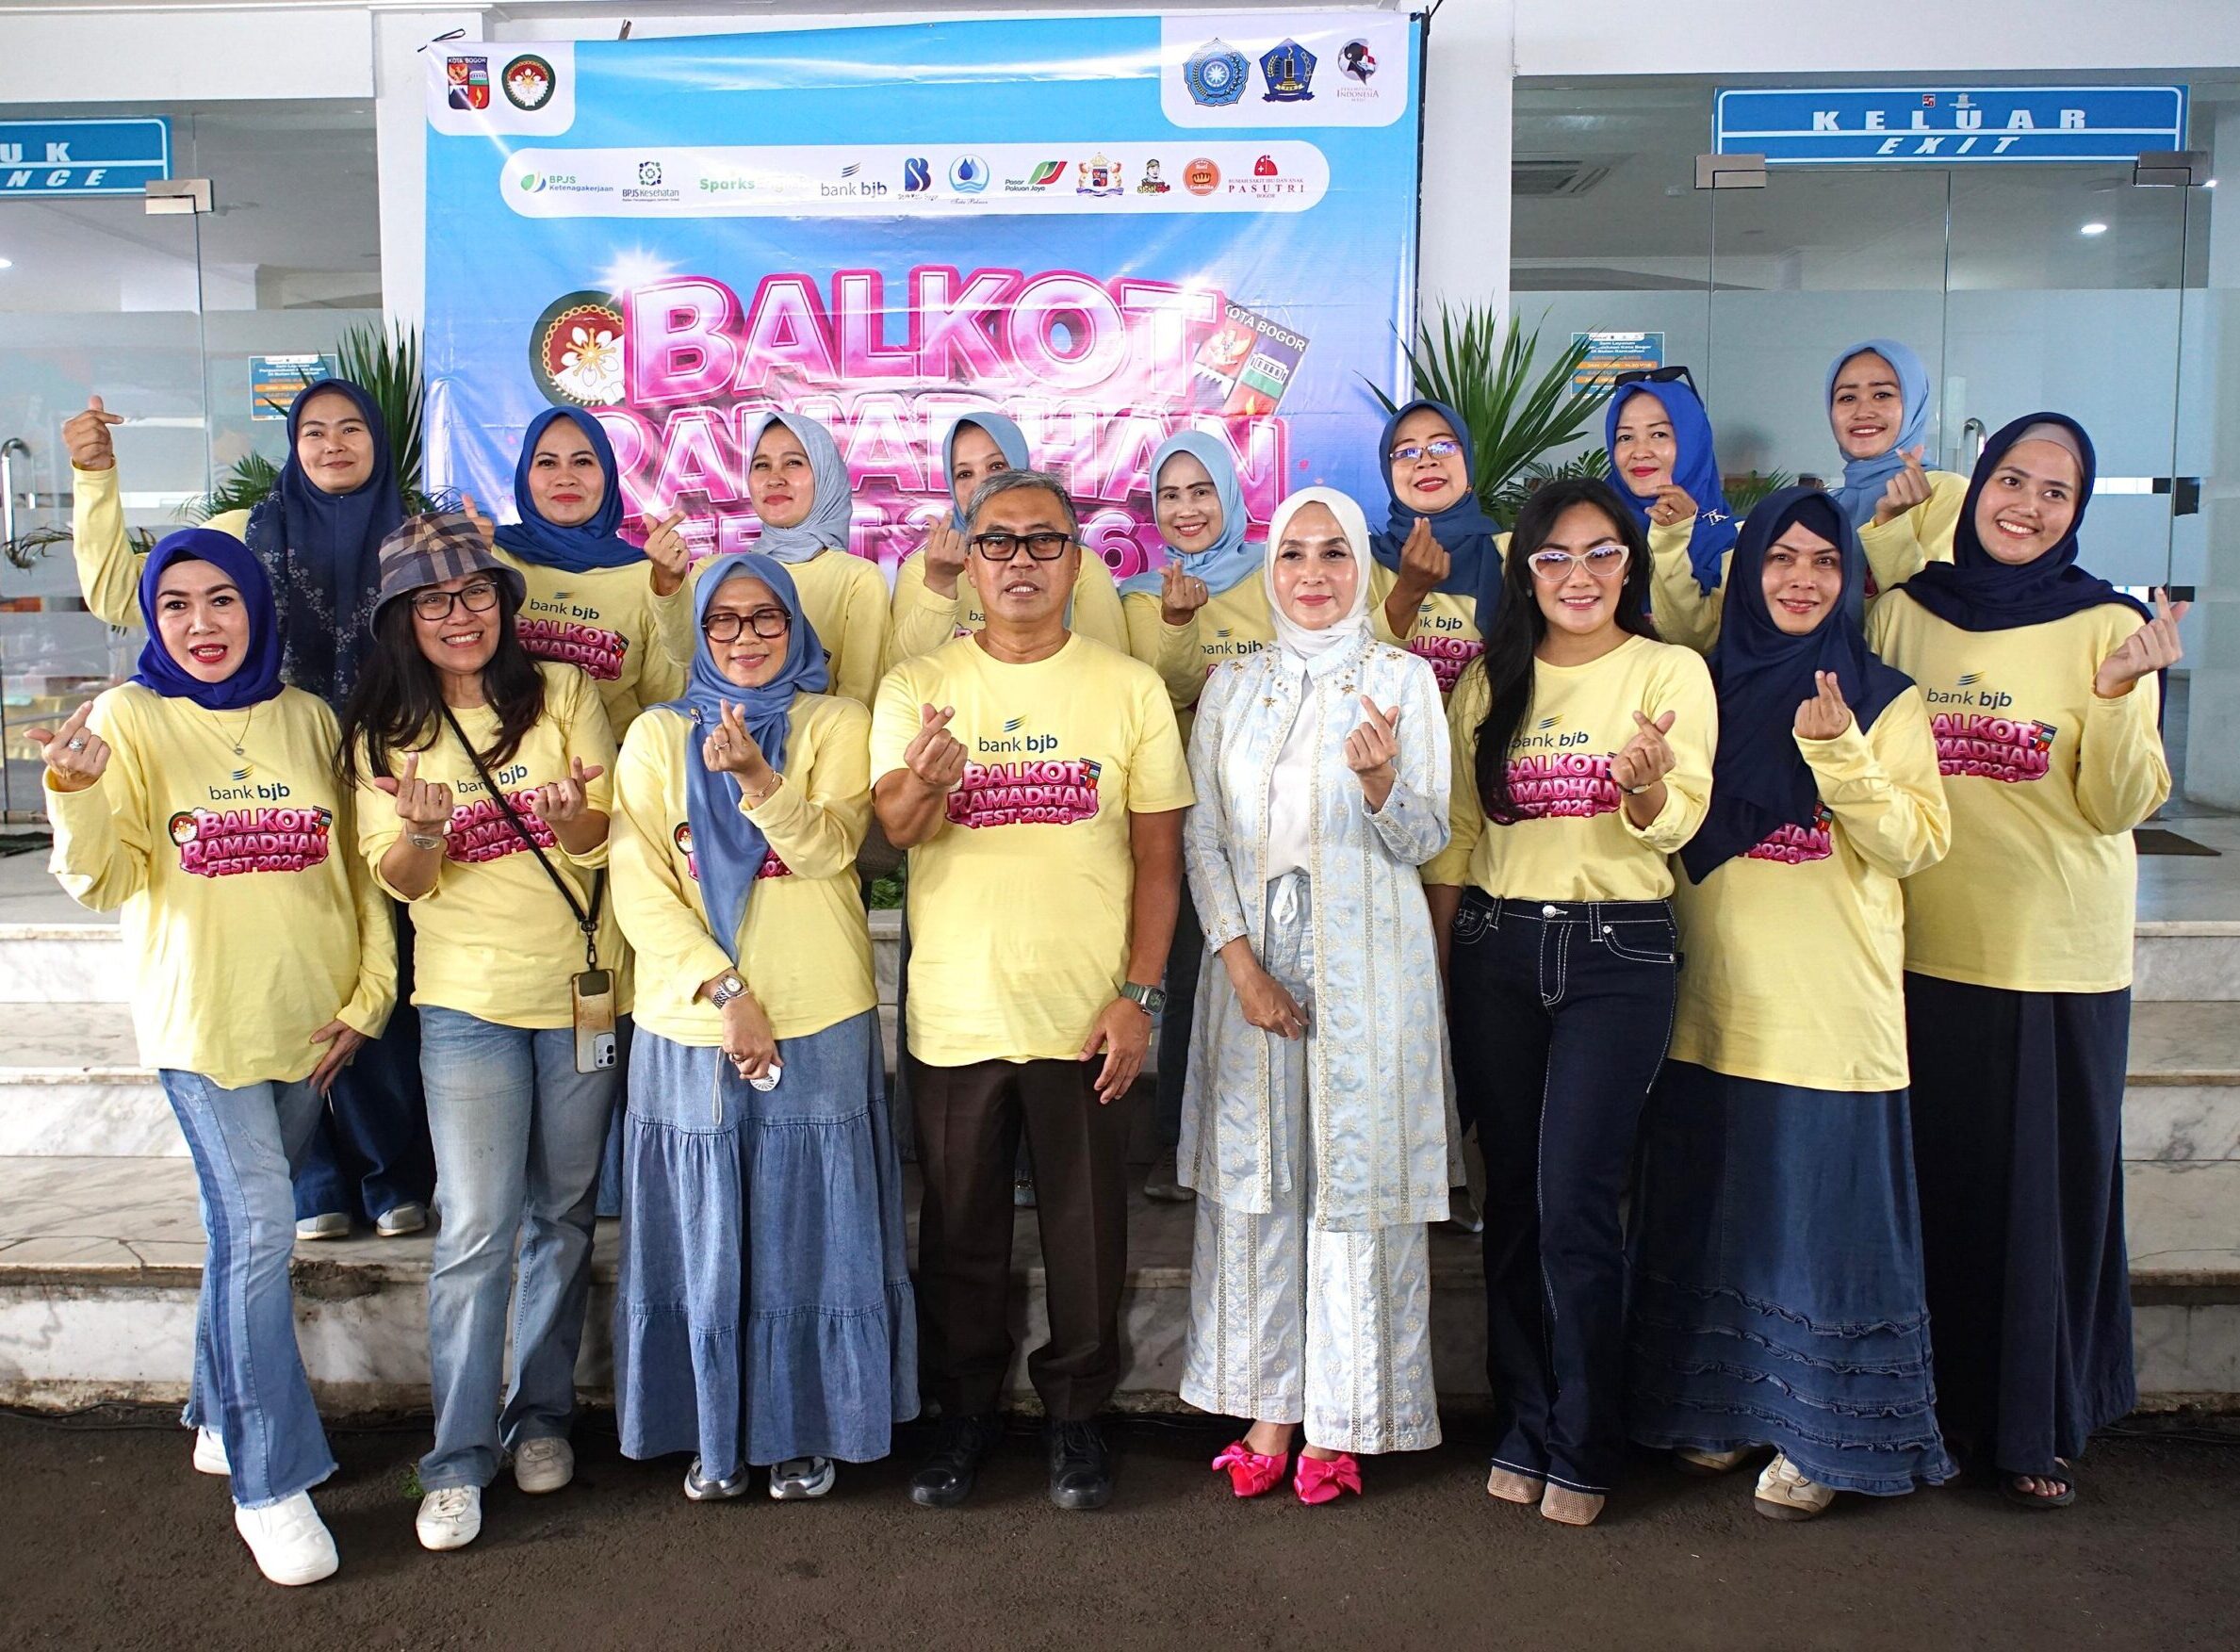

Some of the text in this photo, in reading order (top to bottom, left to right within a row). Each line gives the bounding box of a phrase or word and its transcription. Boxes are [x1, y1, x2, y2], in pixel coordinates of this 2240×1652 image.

[1336, 90, 1380, 98] INDONESIA
[1813, 108, 2085, 131] KELUAR
[1876, 137, 2019, 155] EXIT
[549, 175, 576, 184] BPJS
[549, 184, 613, 193] Ketenagakerjaan
[699, 177, 756, 193] Sparks
[821, 182, 857, 197] bank
[860, 180, 888, 199] bjb
[1228, 184, 1304, 193] PASUTRI
[626, 267, 1227, 406] BALKOT
[1256, 320, 1306, 352] BOGOR
[530, 598, 599, 620] bank bjb
[1435, 616, 1463, 631] bjb
[519, 640, 623, 672] MADHAN
[1926, 688, 2012, 710] bank bjb
[1559, 731, 1589, 747] bjb
[1932, 713, 2036, 747] ALKOT
[978, 734, 1058, 753] bank bjb
[1936, 738, 2049, 771] MADHAN
[456, 764, 528, 794] ban bjb
[963, 761, 1085, 790] BALKOT
[1938, 759, 2018, 781] ST 2026
[209, 783, 291, 801] bank bjb
[948, 785, 1097, 816] RAMADHAN
[1508, 777, 1621, 805] MADHAN
[452, 788, 544, 833] BALKO
[971, 806, 1072, 826] FEST 2026
[1551, 799, 1594, 817] 2026
[197, 808, 318, 840] BALKOT
[181, 833, 328, 866] RAMADHAN
[467, 829, 554, 861] FEST 226
[1750, 842, 1799, 862] 2026
[206, 854, 303, 876] FEST 2026
